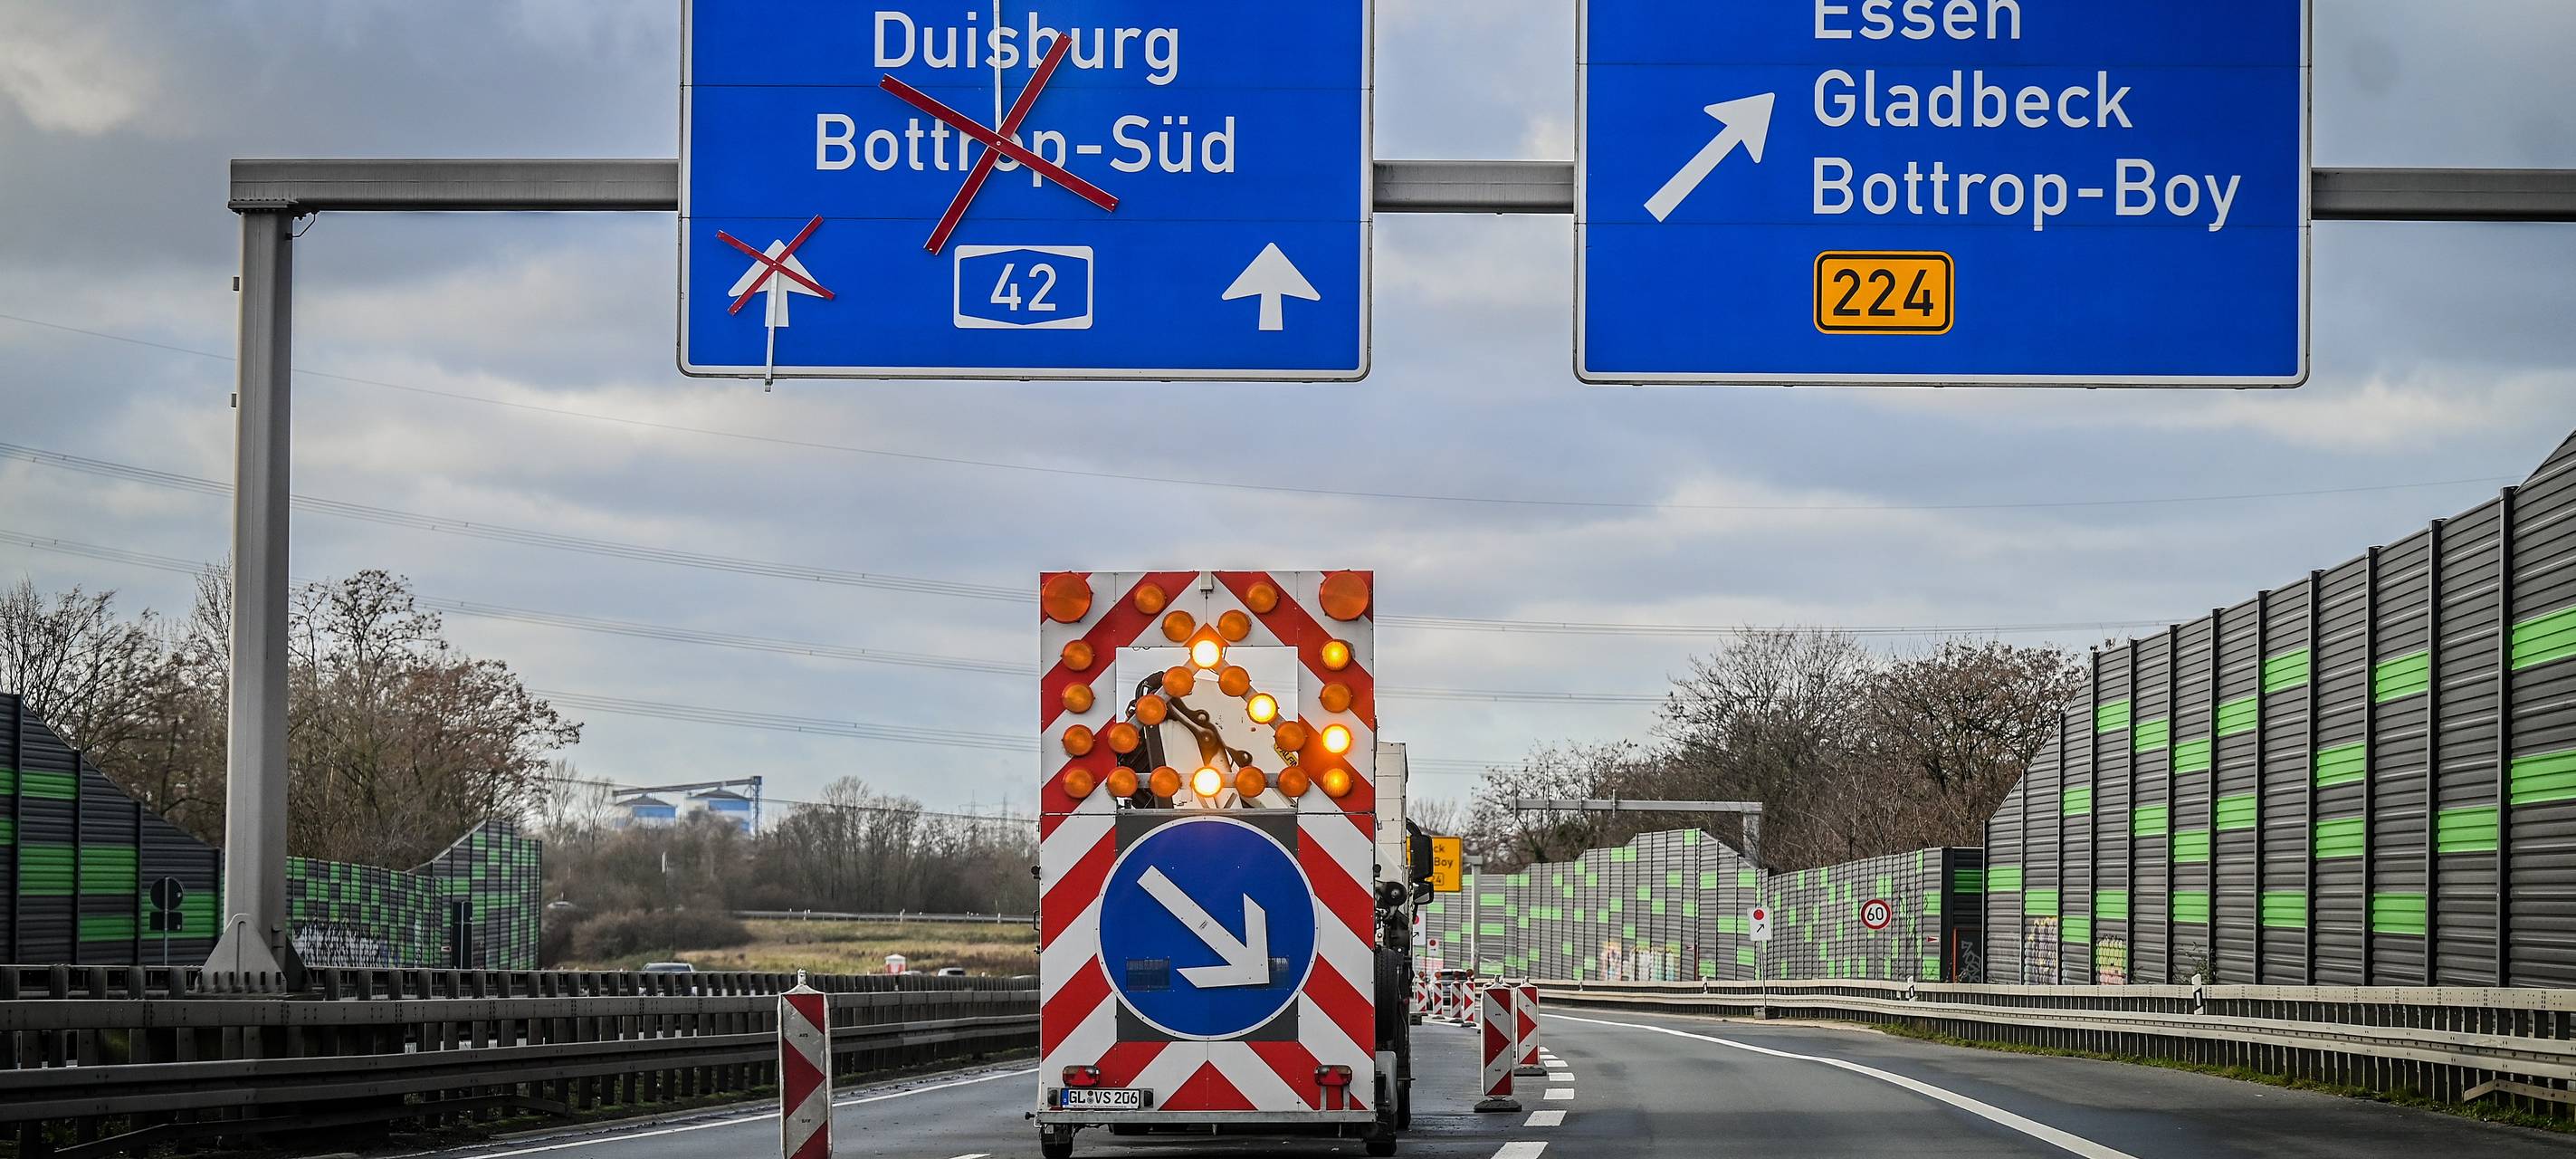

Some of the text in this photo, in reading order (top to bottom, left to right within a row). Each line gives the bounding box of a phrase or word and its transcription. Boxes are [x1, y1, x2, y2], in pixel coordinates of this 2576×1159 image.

[1815, 0, 2020, 40] Essen
[874, 11, 1178, 86] Duisburg
[1814, 69, 2133, 129] Gladbeck
[1813, 157, 2241, 232] Bottrop-Boy
[990, 263, 1056, 311] 42
[1833, 268, 1934, 317] 224
[1866, 906, 1884, 921] 60
[1069, 1091, 1138, 1105] GL VS 206
